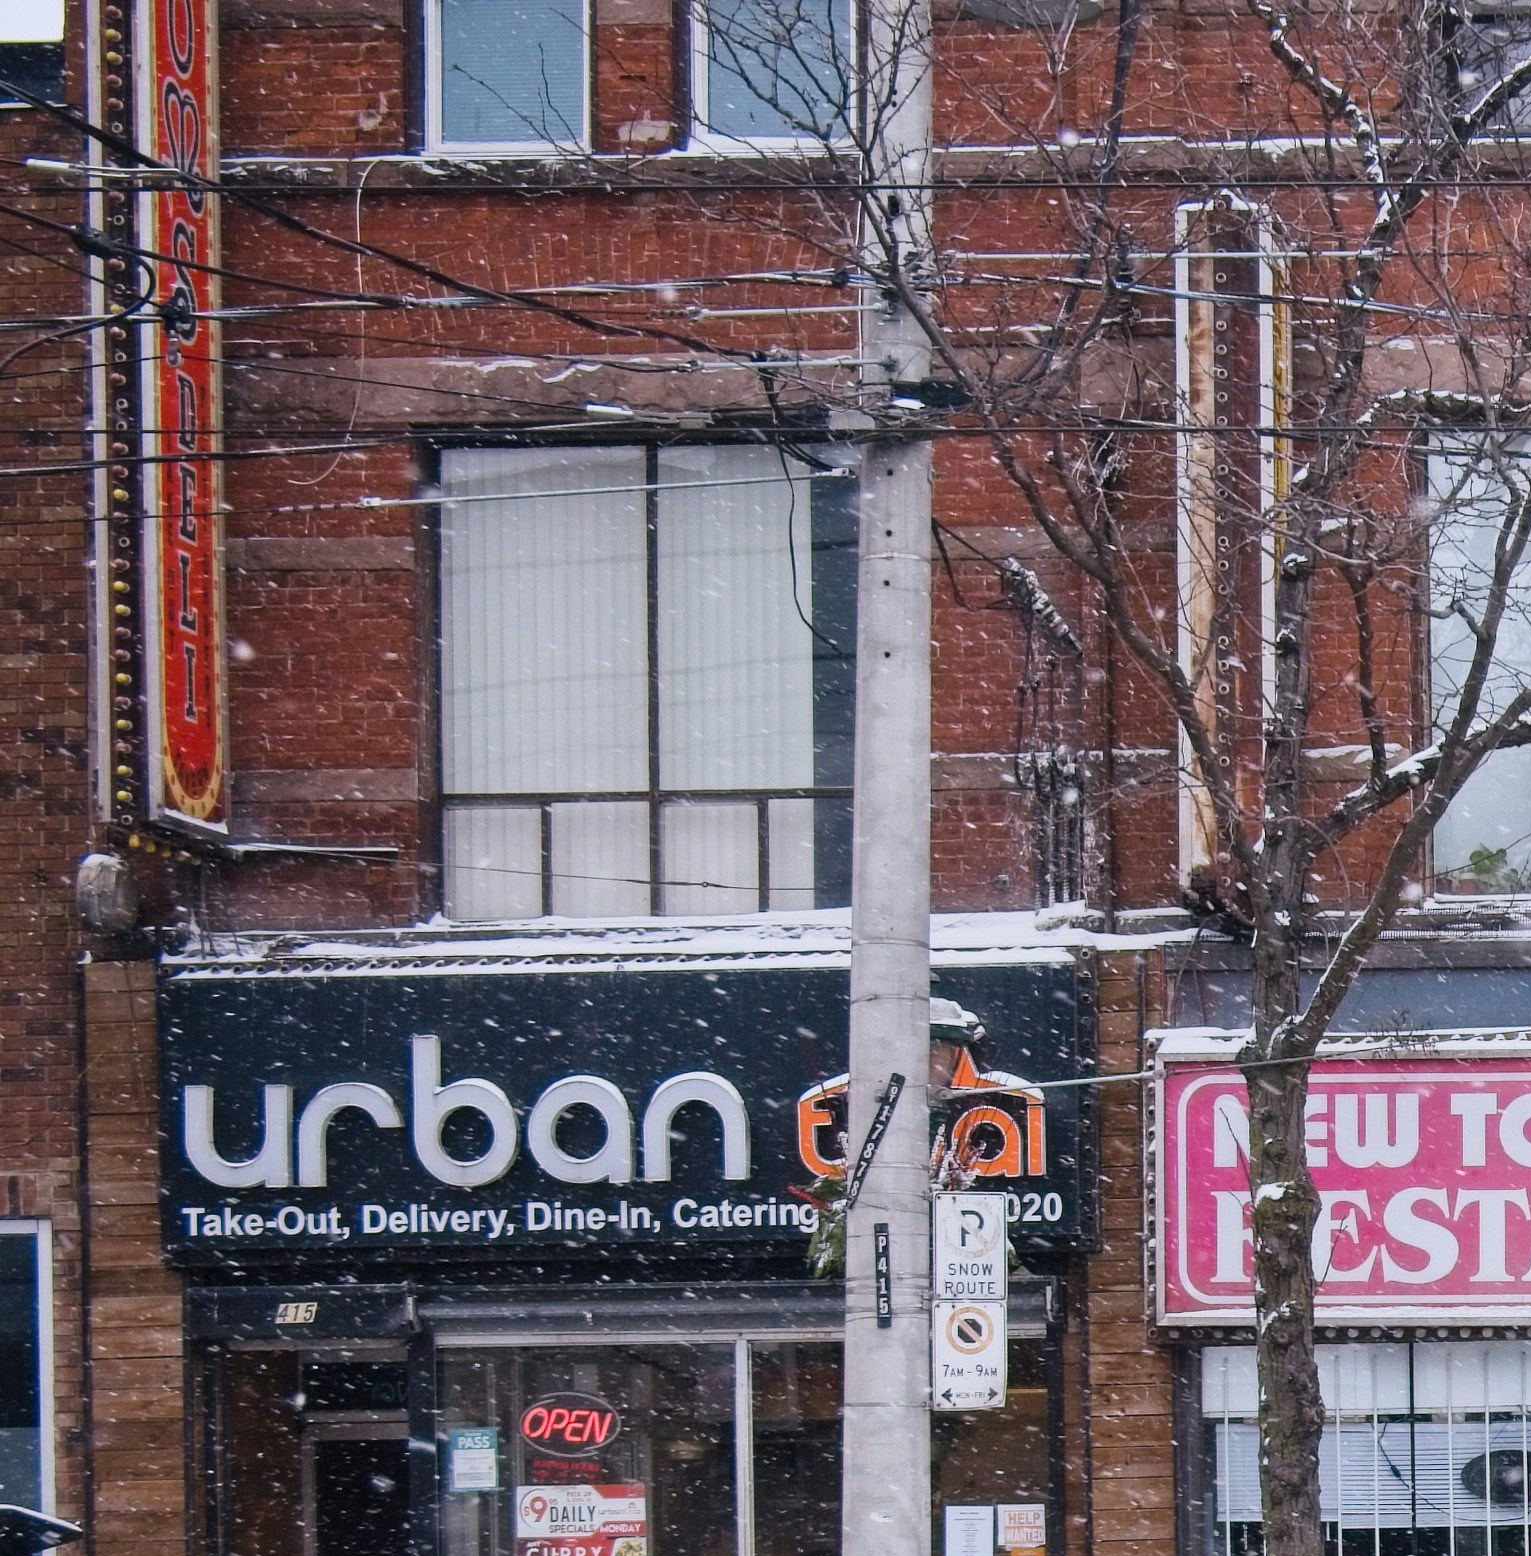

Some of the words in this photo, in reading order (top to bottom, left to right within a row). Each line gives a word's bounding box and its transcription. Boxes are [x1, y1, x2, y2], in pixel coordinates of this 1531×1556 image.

[176, 368, 199, 724] DELI
[183, 1033, 750, 1188] urban
[798, 1080, 1046, 1178] tai
[183, 1206, 350, 1239] Take-Out,
[362, 1203, 516, 1239] Delivery,
[526, 1200, 662, 1234] Dine-In,
[673, 1197, 820, 1234] Catering
[948, 1263, 993, 1277] SNOW
[945, 1281, 996, 1295] ROUTE
[279, 1304, 316, 1322] 415
[523, 1407, 613, 1444] OPEN
[457, 1435, 491, 1449] PASS
[550, 1505, 596, 1523] DAILY
[1008, 1512, 1040, 1526] HELP
[600, 1523, 641, 1533] MONDAY
